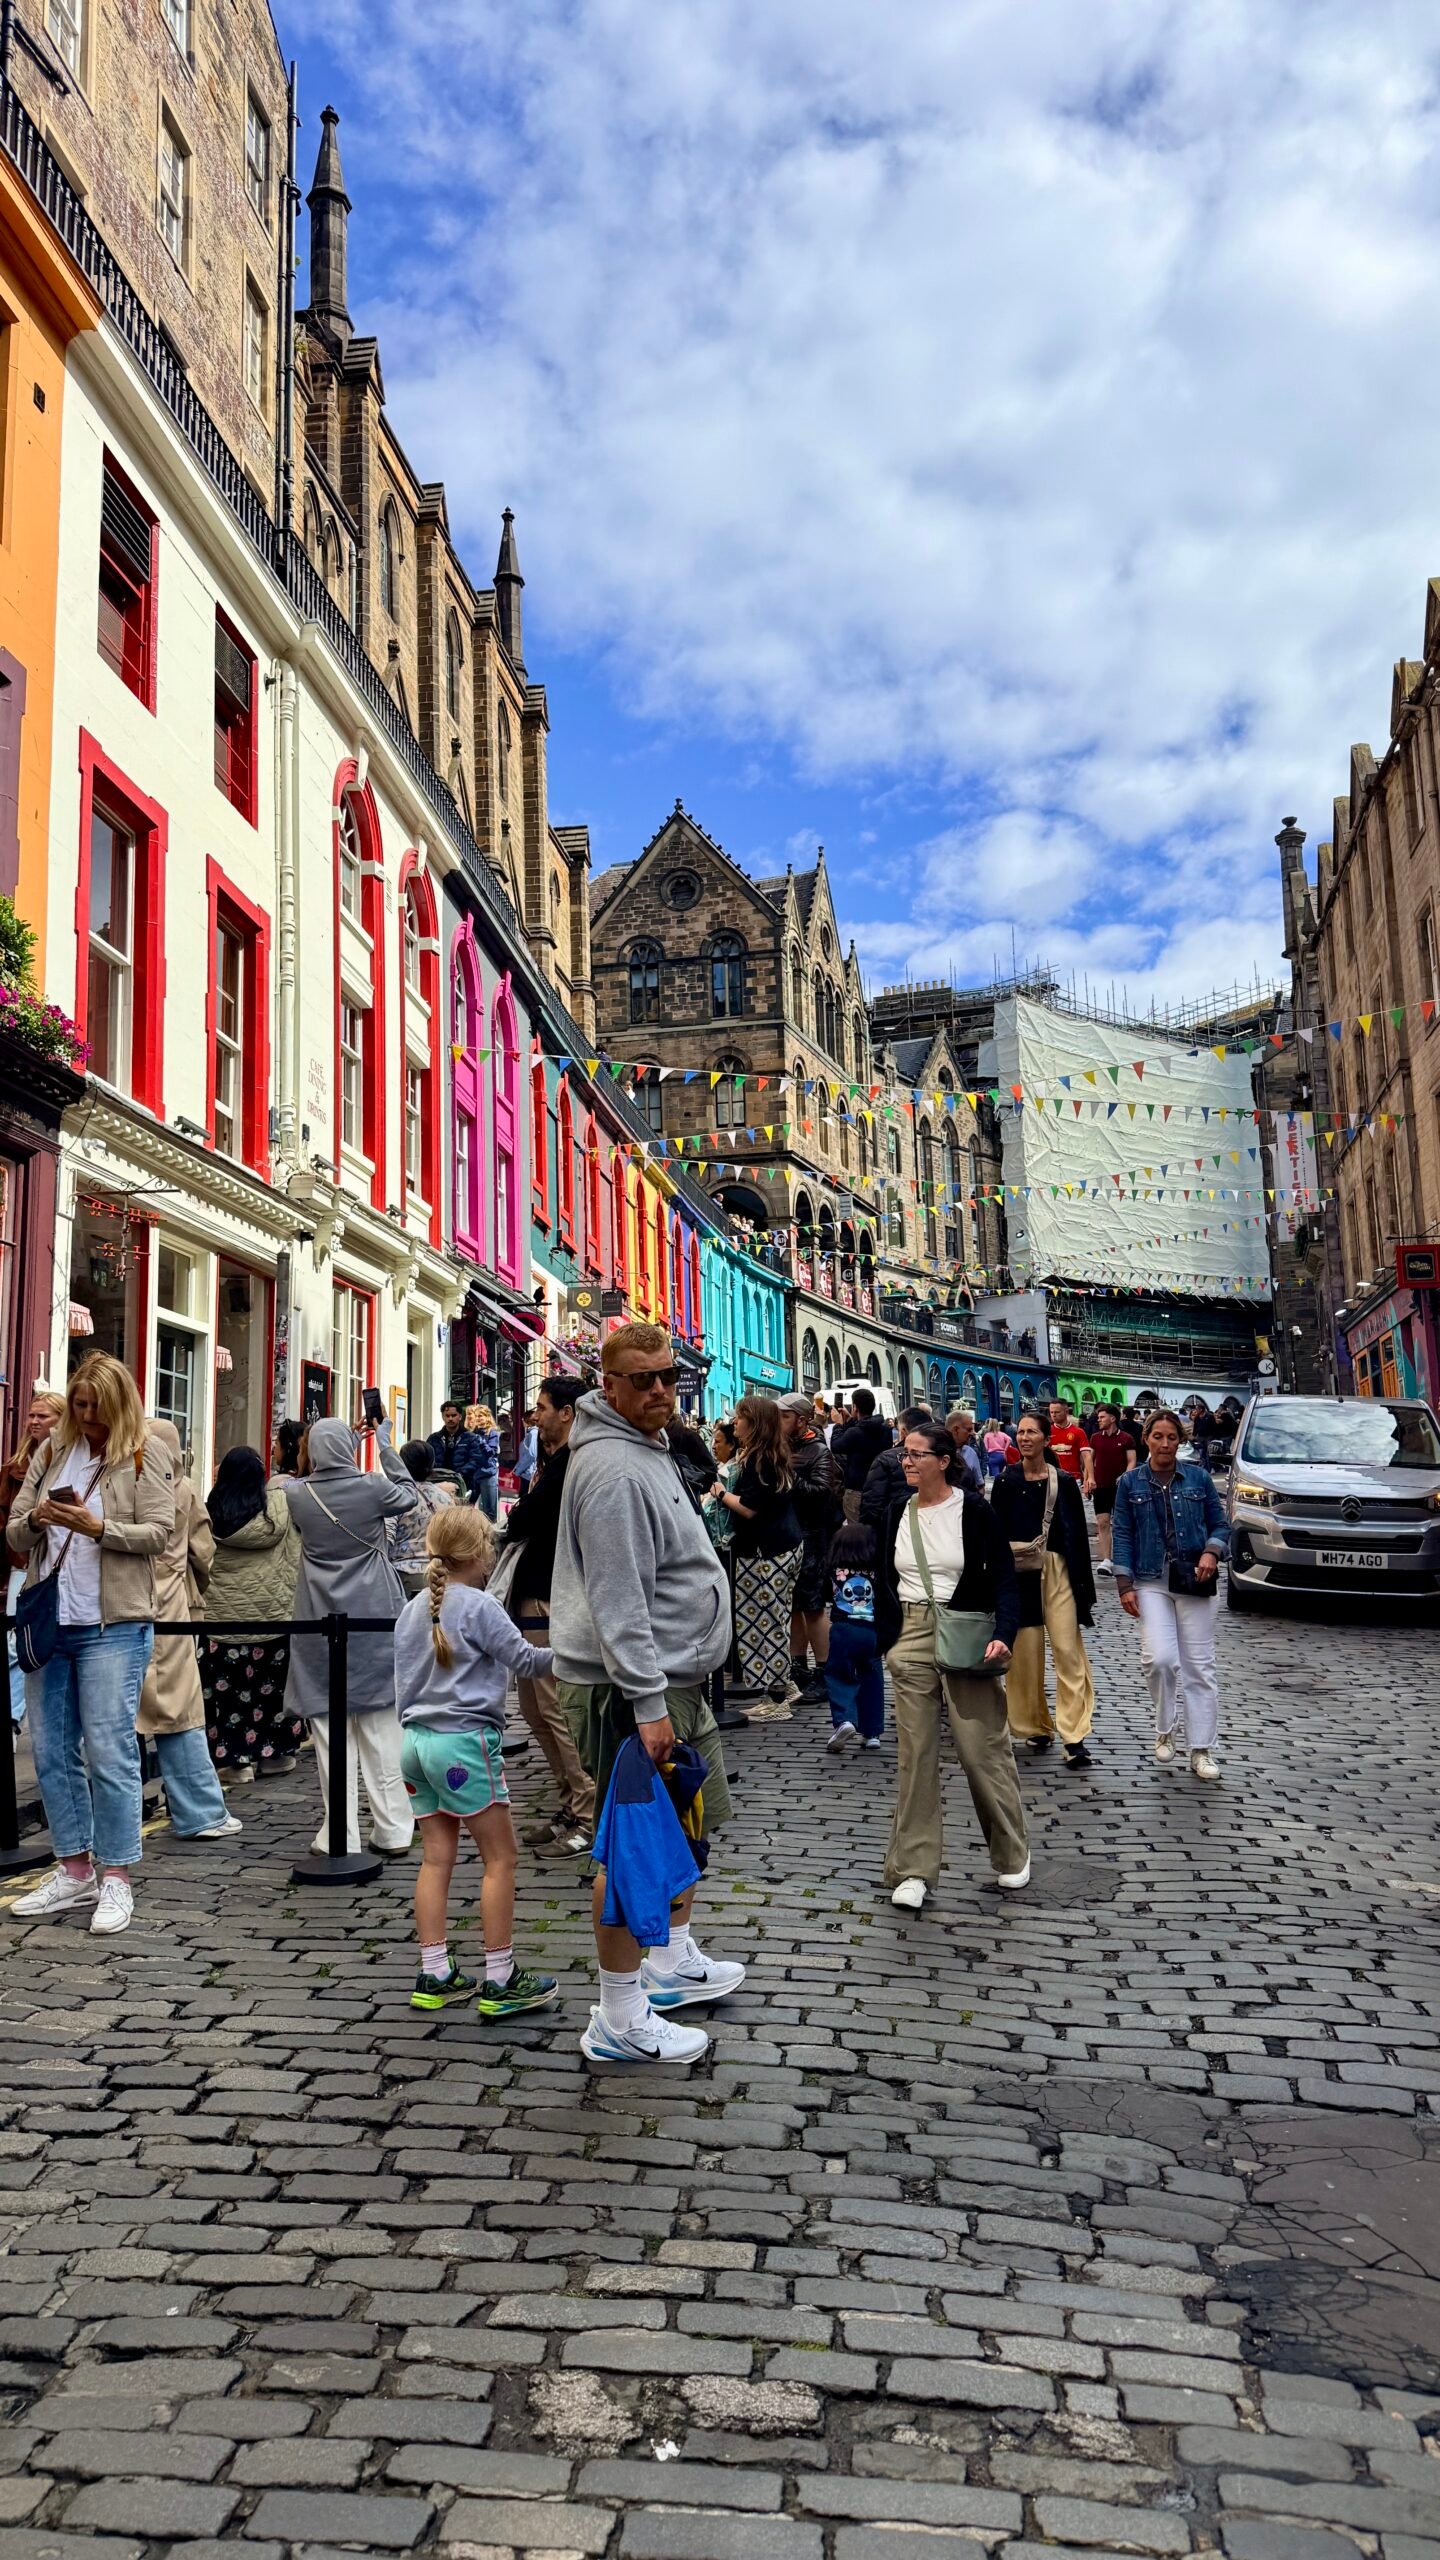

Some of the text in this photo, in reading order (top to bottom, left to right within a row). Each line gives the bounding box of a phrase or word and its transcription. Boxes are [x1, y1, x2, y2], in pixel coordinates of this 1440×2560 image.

[308, 1070, 327, 1095] DINING
[315, 1091, 320, 1104] &
[307, 1100, 327, 1125] DRINKS
[1321, 1552, 1383, 1567] WH74 AGO
